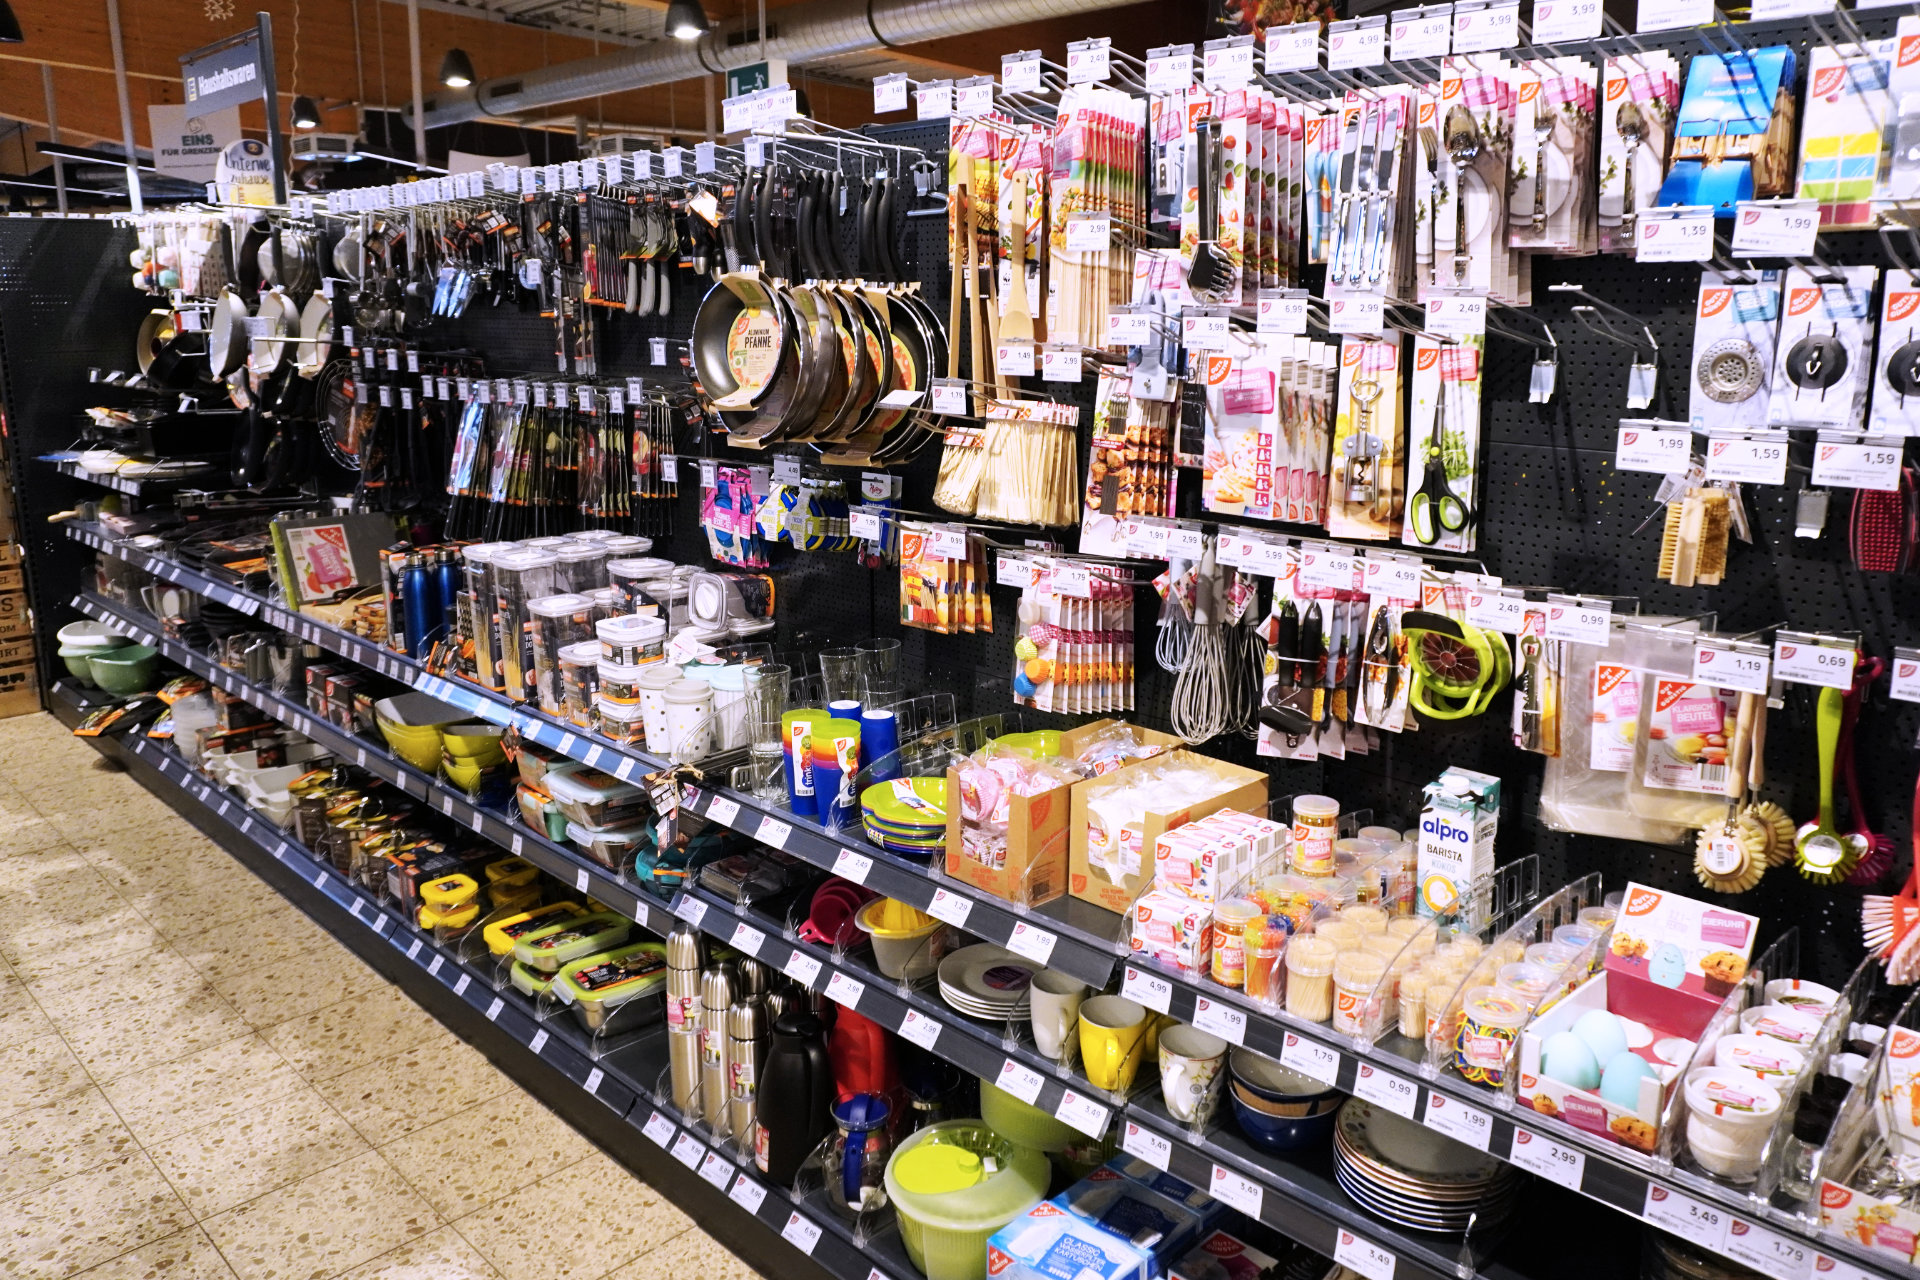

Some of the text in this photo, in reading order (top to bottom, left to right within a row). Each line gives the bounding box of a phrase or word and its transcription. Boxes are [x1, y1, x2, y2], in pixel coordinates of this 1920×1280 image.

[1571, 3, 1596, 16] 3,99
[1488, 15, 1511, 27] 3,99
[1423, 23, 1444, 36] 4,99
[1294, 38, 1313, 49] 5,99
[1359, 35, 1379, 46] 4,99
[1090, 53, 1105, 63] 2,49
[1231, 53, 1248, 63] 1,99
[1023, 66, 1037, 74] 1,99
[1170, 61, 1187, 71] 4,99
[198, 62, 256, 96] Haushaltswaren
[977, 90, 989, 99] 1,79
[181, 133, 214, 147] EINS
[161, 147, 180, 157] FÜR
[1784, 216, 1811, 229] 1,99
[1090, 224, 1106, 234] 2,99
[1681, 225, 1706, 237] 1,39
[1285, 305, 1303, 314] 6,99
[1360, 303, 1379, 313] 2,99
[1459, 303, 1480, 314] 2,49
[1131, 319, 1146, 328] 2,99
[1208, 323, 1224, 332] 3,99
[744, 333, 772, 349] PFANNE
[1018, 351, 1031, 360] 1,49
[1064, 356, 1078, 365] 2,99
[950, 391, 963, 400] 1,79
[1659, 438, 1684, 450] 1,99
[1752, 447, 1780, 460] 1,59
[1863, 451, 1896, 465] 1,59
[1149, 531, 1164, 540] 1,99
[1182, 535, 1198, 544] 2,99
[1265, 550, 1282, 561] 5,99
[1016, 565, 1029, 574] 1,79
[1329, 561, 1348, 571] 4,99
[1071, 572, 1086, 581] 1,79
[1395, 570, 1415, 581] 4,99
[1498, 602, 1520, 614] 2,49
[1581, 614, 1604, 626] 0,99
[1735, 658, 1761, 671] 1,19
[1818, 654, 1847, 667] 0,69
[1676, 711, 1717, 722] BEUTEL
[1422, 817, 1470, 843] alpro
[1305, 841, 1330, 850] PARTY
[1426, 843, 1464, 863] BARISTA
[1430, 860, 1457, 874] KOKOS
[1702, 917, 1746, 929] EIERUHR
[1036, 934, 1051, 946] 1,99
[1222, 948, 1244, 958] PART
[1222, 955, 1244, 964] PICKE
[1149, 980, 1167, 994] 4,99
[1223, 1011, 1241, 1025] 1,99
[922, 1022, 937, 1034] 2,99
[1313, 1048, 1334, 1063] 1,79
[1023, 1073, 1039, 1087] 2,49
[1389, 1080, 1411, 1096] 0,99
[1084, 1104, 1102, 1118] 3,49
[1564, 1100, 1604, 1117] EIERUHR
[1463, 1110, 1486, 1127] 1,99
[1150, 1137, 1168, 1152] 3,49
[1551, 1147, 1577, 1165] 2,99
[1240, 1181, 1259, 1197] 3,49
[1689, 1204, 1719, 1226] 3,49
[1063, 1237, 1101, 1257] CLASSIC
[1773, 1240, 1804, 1262] 1,79
[1054, 1247, 1105, 1272] KARTUSCHEN
[1369, 1249, 1390, 1266] 3,49
